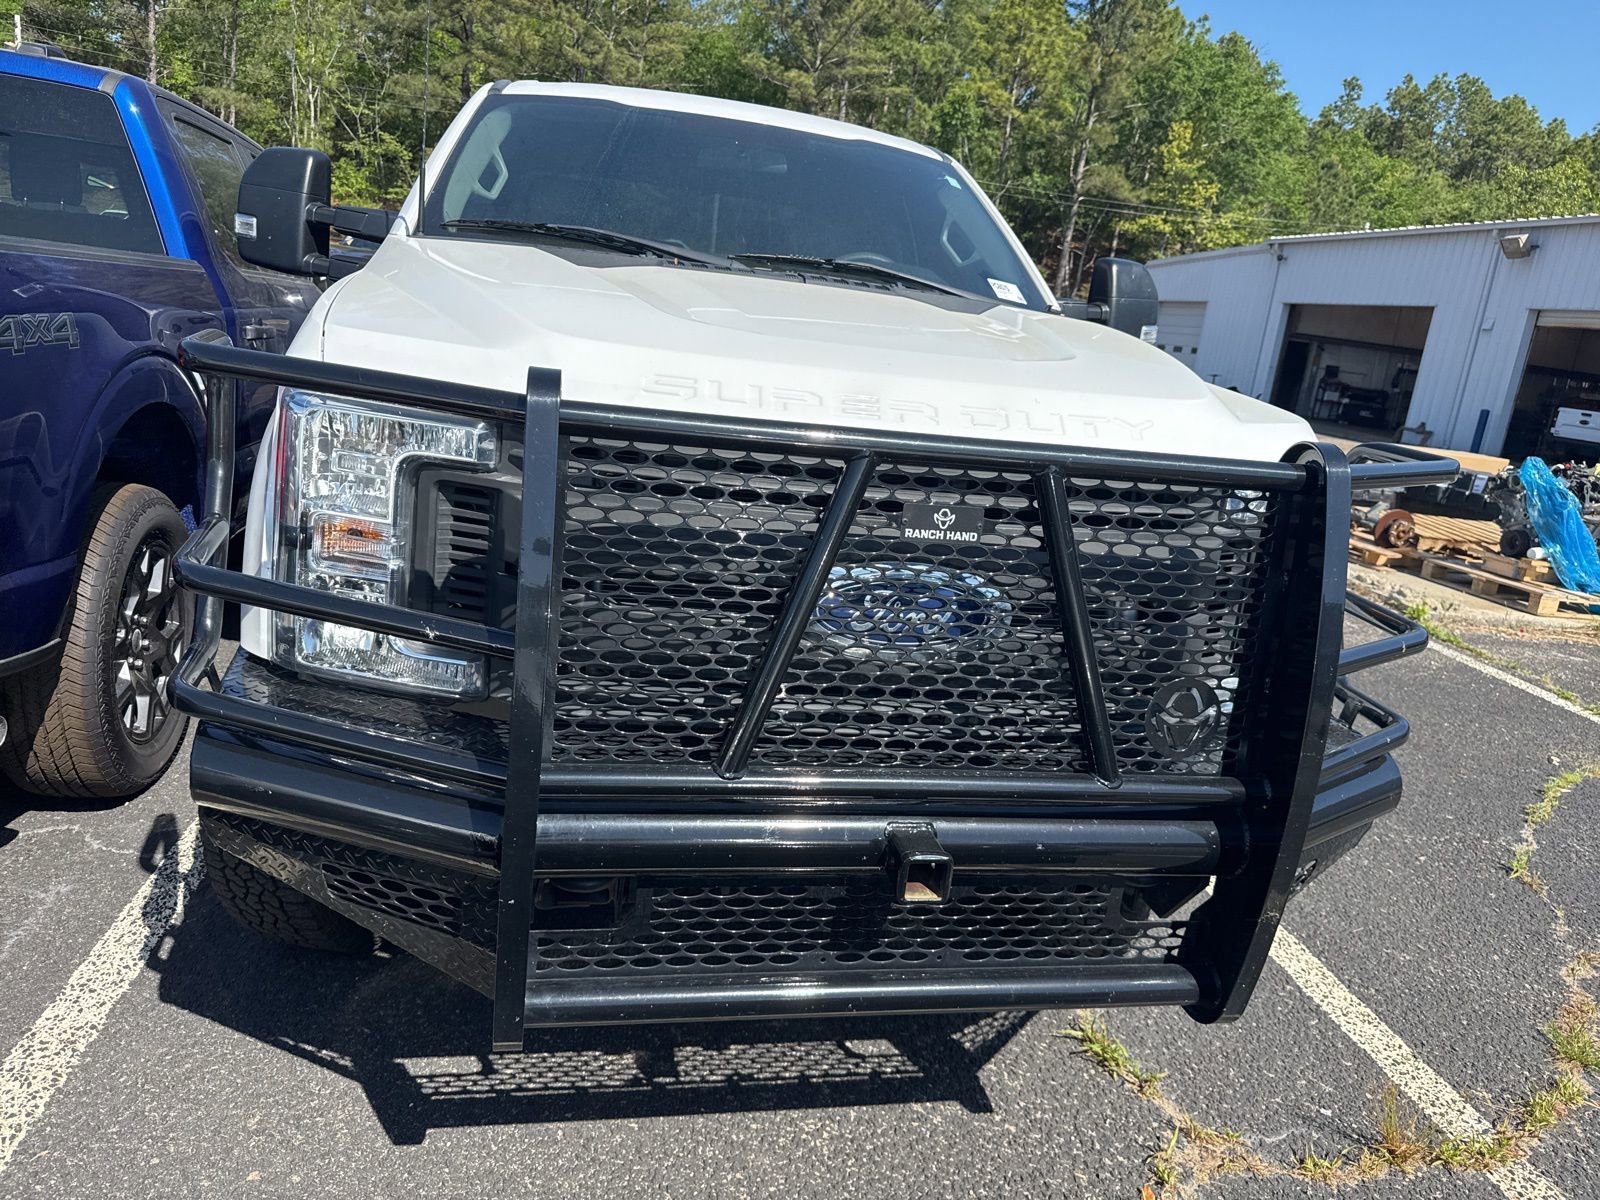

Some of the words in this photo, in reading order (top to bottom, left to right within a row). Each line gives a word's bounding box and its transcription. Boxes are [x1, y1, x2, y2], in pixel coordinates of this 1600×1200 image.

[639, 373, 939, 426] SUPER
[959, 404, 1154, 441] DUTY
[904, 528, 945, 540] RANCH
[946, 530, 978, 542] HAND
